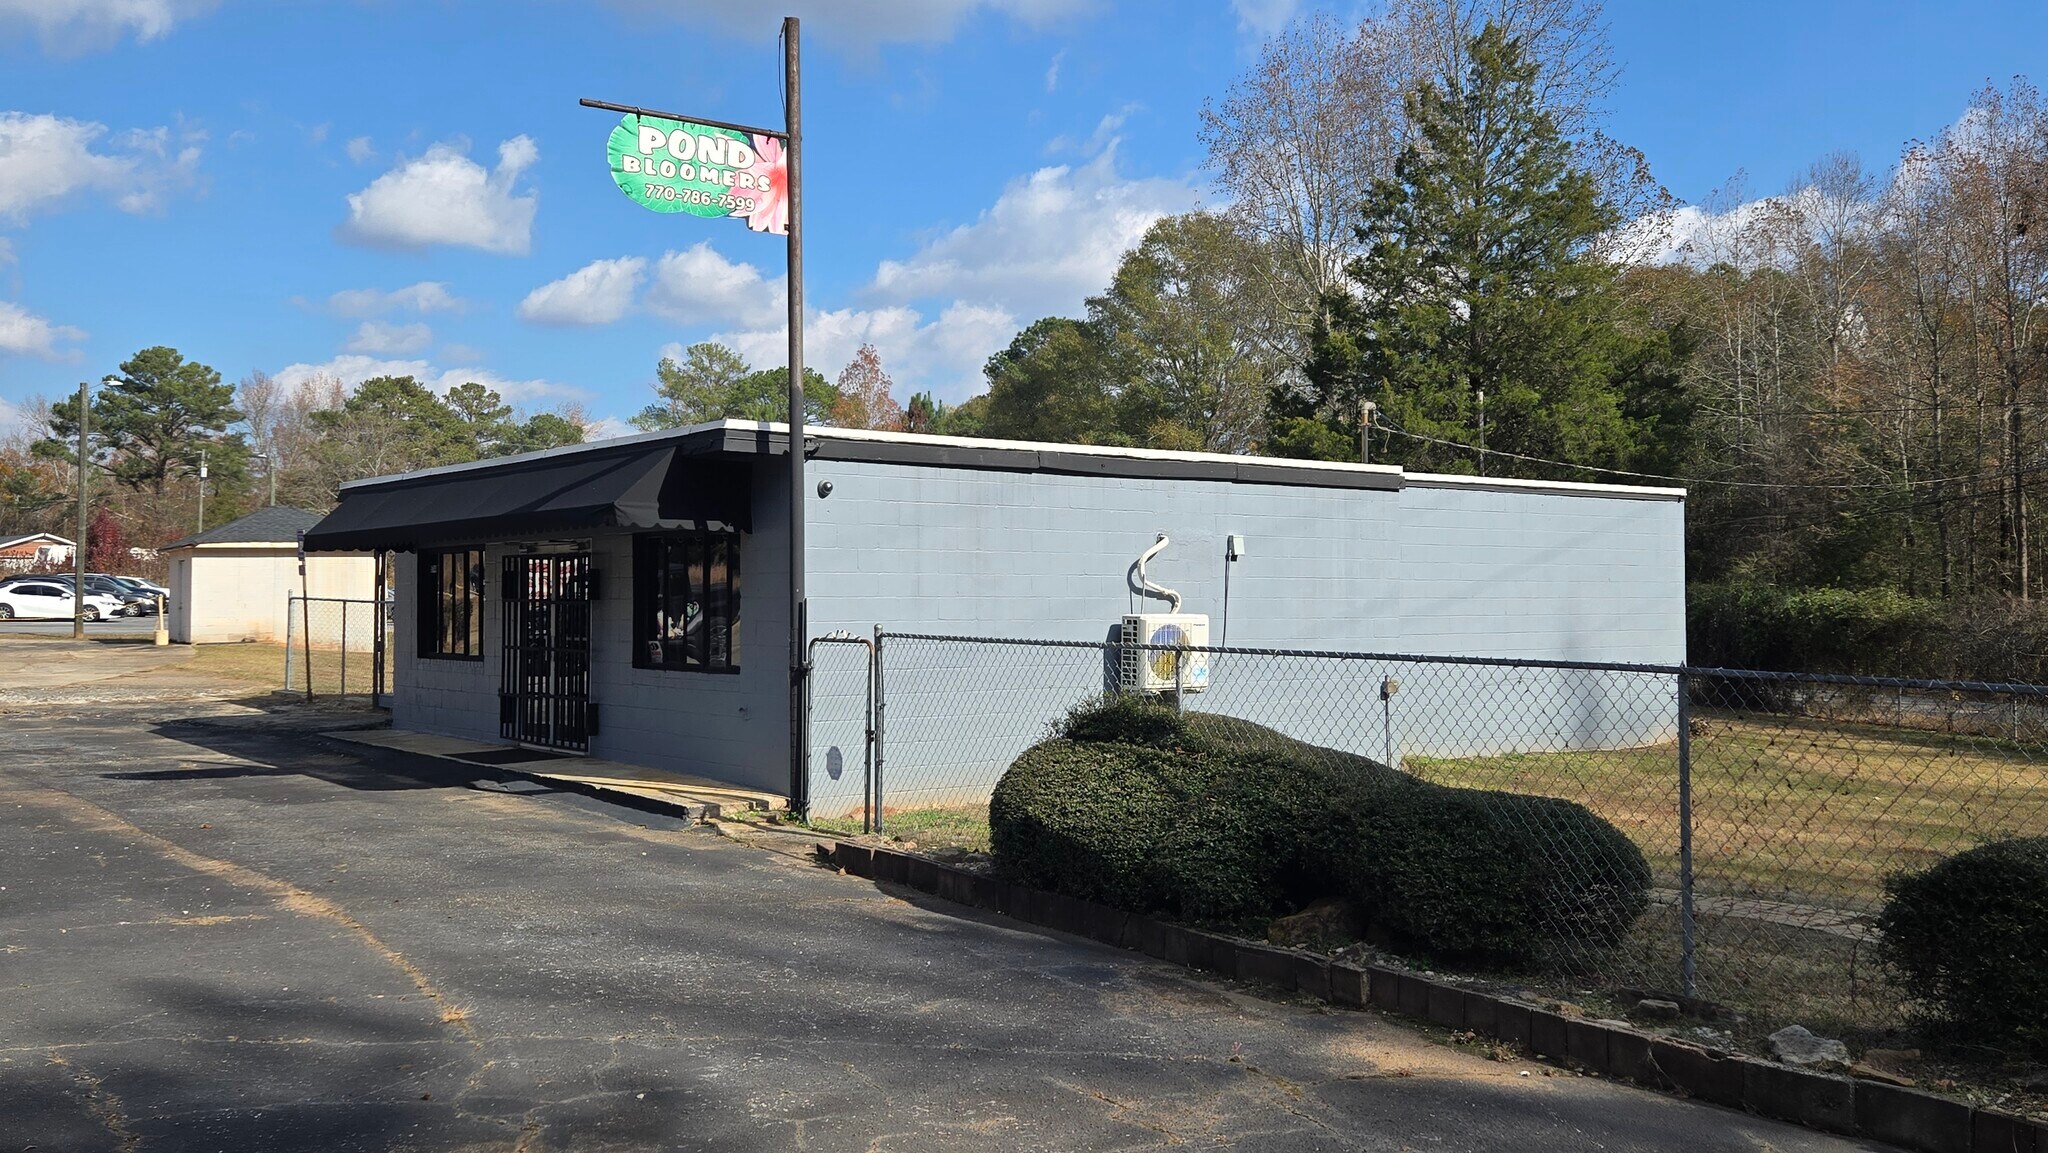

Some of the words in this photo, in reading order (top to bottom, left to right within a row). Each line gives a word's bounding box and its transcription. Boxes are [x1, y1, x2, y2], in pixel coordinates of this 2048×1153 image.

[638, 125, 756, 170] POND
[622, 154, 772, 193] BLOOMERS
[645, 184, 756, 212] 770-786-7599
